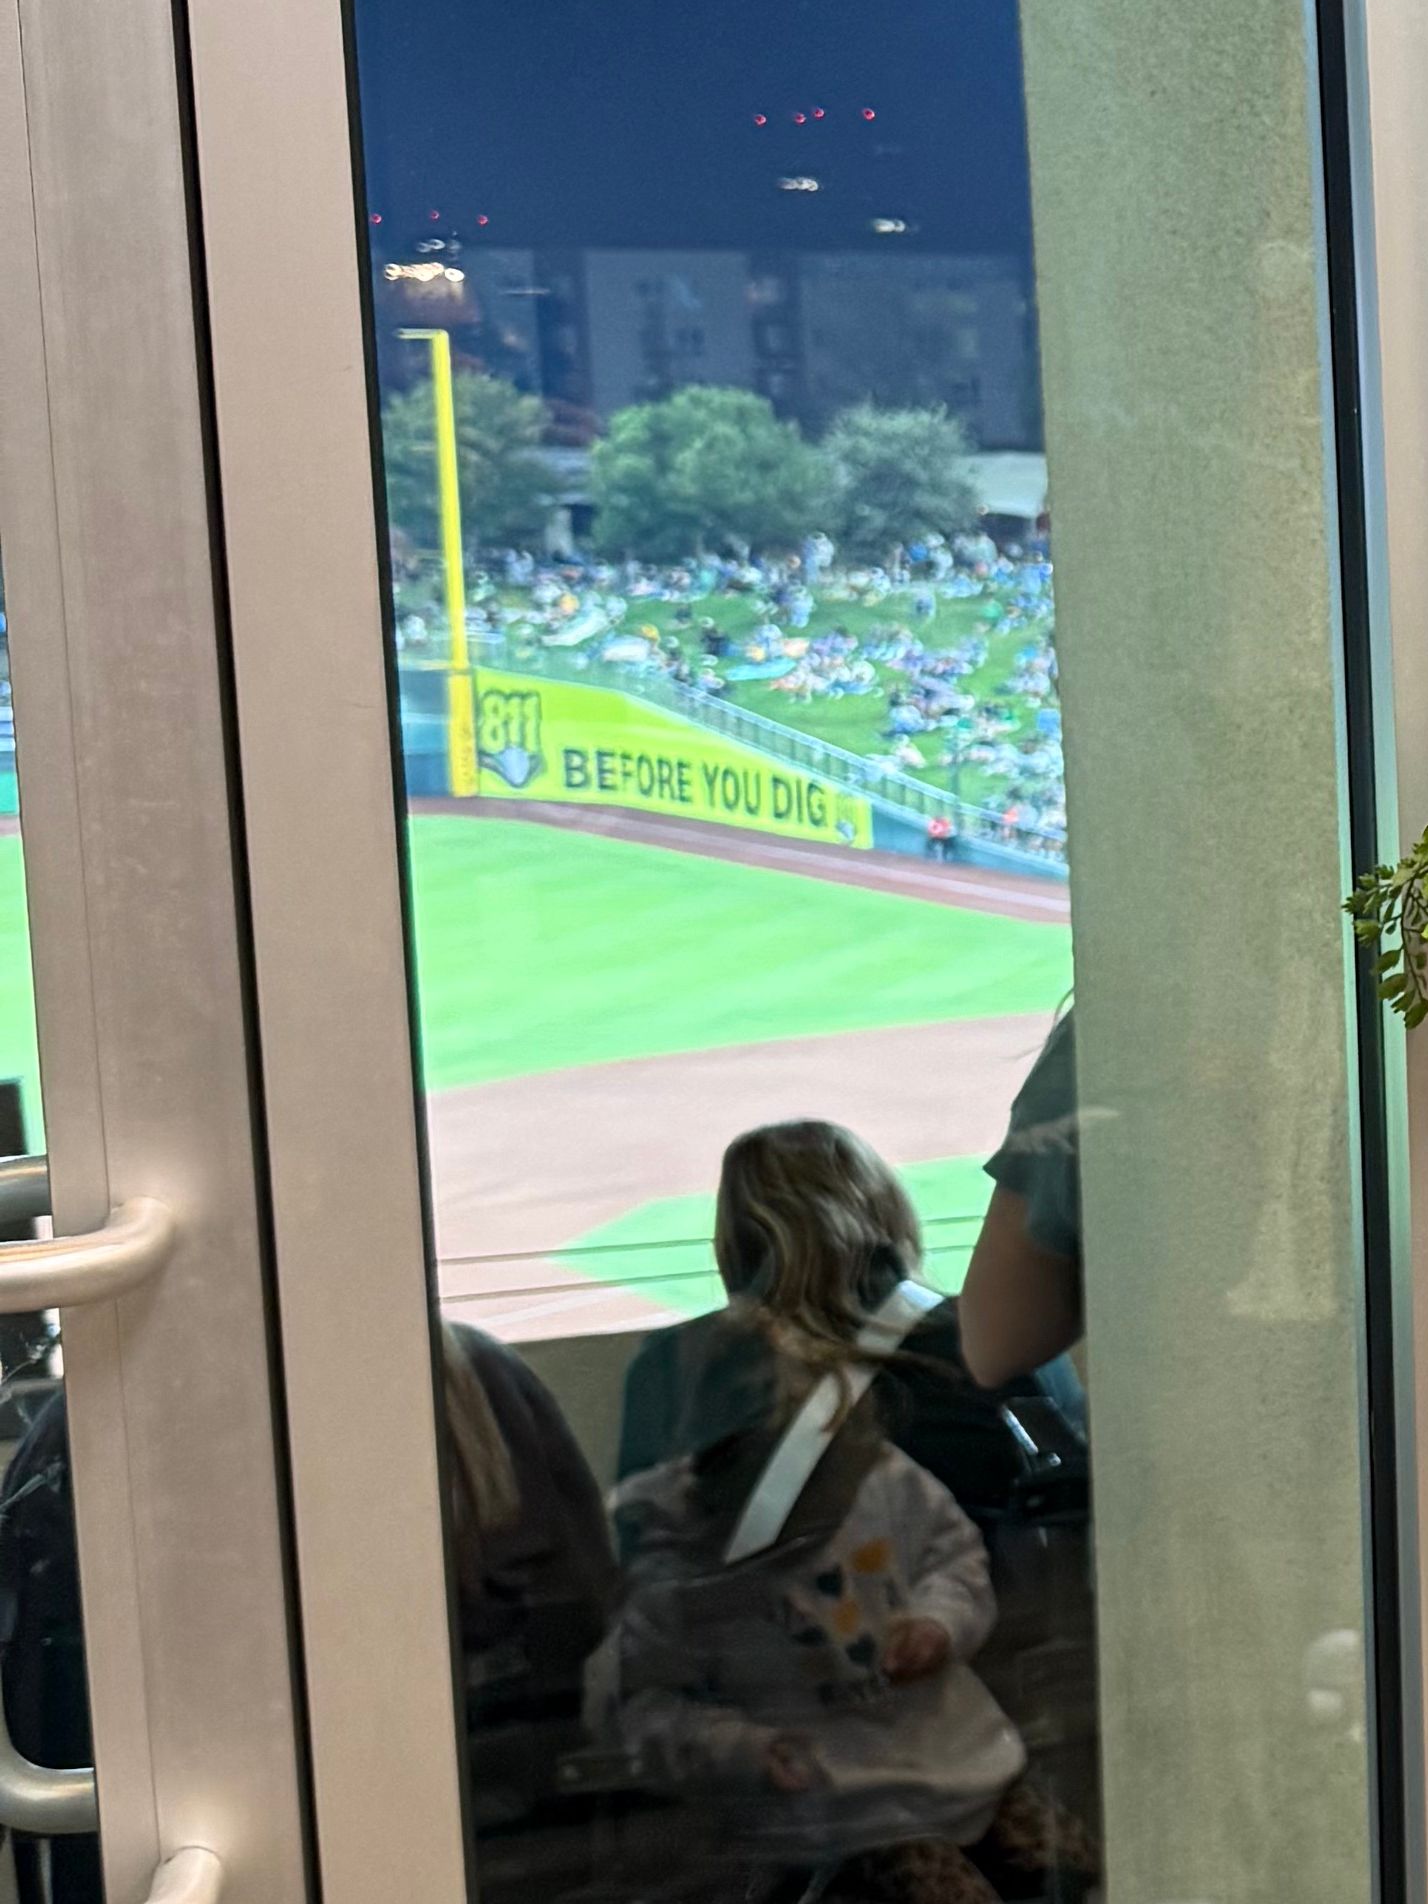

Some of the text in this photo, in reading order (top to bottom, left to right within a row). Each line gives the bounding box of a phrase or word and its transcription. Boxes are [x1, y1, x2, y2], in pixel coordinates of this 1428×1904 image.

[478, 688, 542, 753] 811
[563, 747, 693, 803] BEFORE
[701, 760, 761, 816] YOU
[771, 774, 829, 828] DIG
